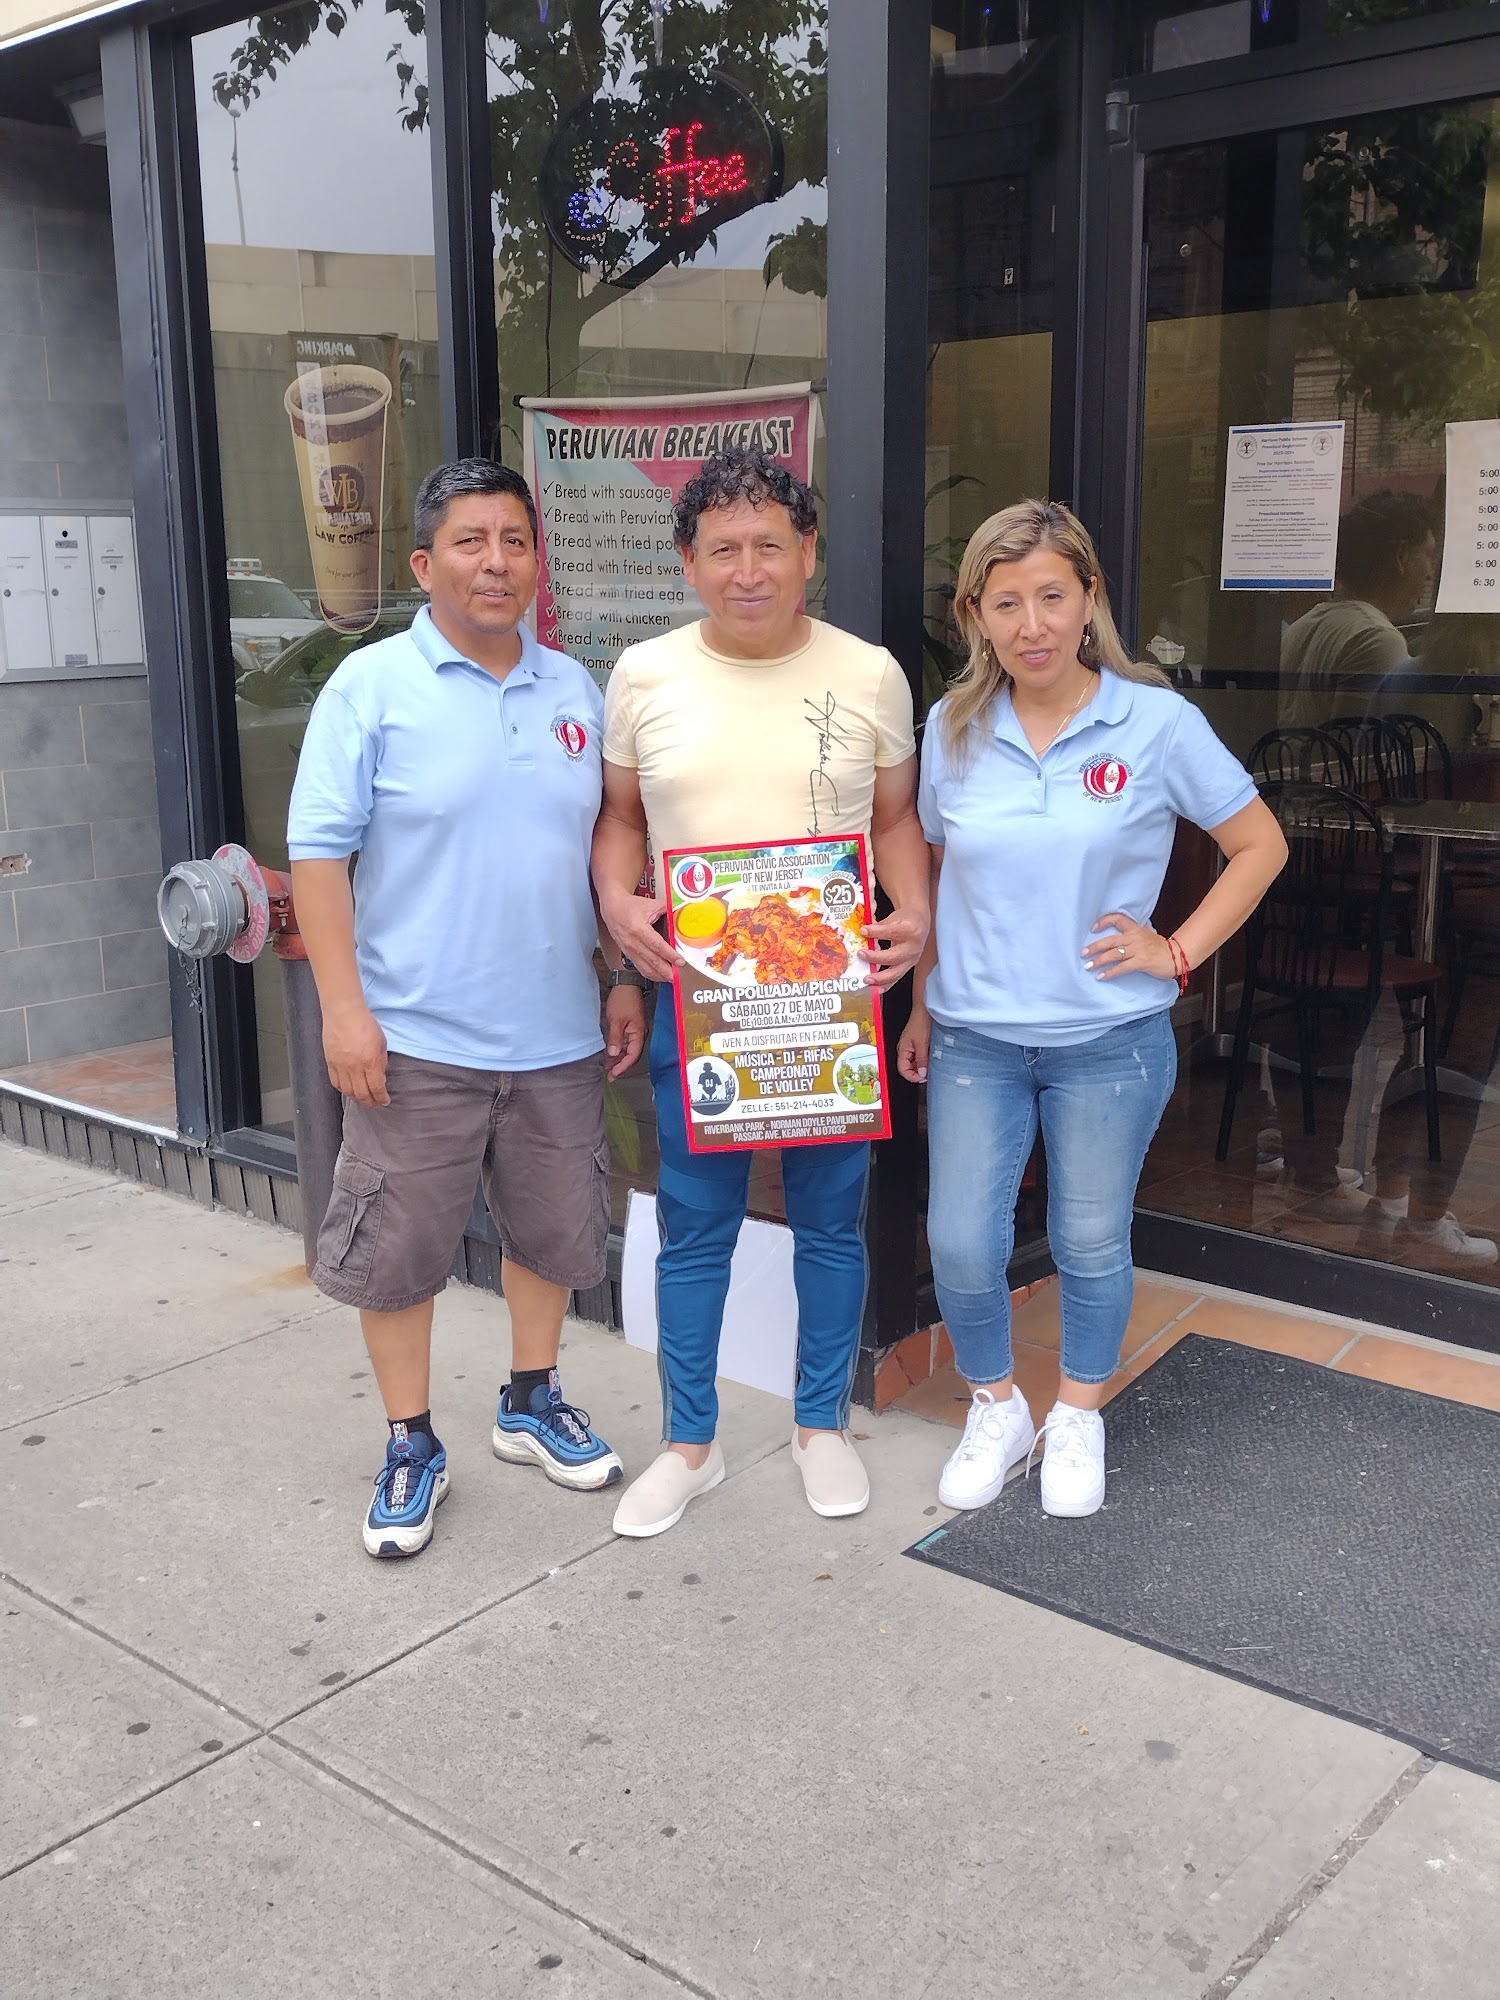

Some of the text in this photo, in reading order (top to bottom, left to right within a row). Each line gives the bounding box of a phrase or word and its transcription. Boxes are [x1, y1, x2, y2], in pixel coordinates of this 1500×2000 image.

[606, 122, 749, 228] Coffee
[545, 419, 793, 460] PERUVIAN BREAKFAST
[1480, 469, 1500, 478] 5:00
[555, 483, 672, 503] Bread with sausage
[1478, 486, 1499, 496] 5:00
[554, 508, 674, 526] Bread with Peruvian
[1478, 505, 1498, 514] 5:00
[315, 525, 336, 543] LAW
[554, 532, 591, 549] Bread
[595, 534, 618, 551] with
[621, 536, 651, 551] fried
[554, 557, 593, 573] Bread
[599, 558, 619, 575] with
[622, 560, 652, 576] fried
[555, 581, 684, 606] Bread with fried egg
[557, 606, 670, 625] Bread with chicken
[558, 630, 592, 645] Bread
[597, 632, 623, 647] with
[714, 853, 831, 873] PERUVIAN CIVIC ASSOCIATION
[742, 868, 804, 884] OF NEW JERSEY
[759, 883, 778, 892] INVITA
[825, 884, 852, 905] $25
[829, 905, 852, 914] INCLUYE
[693, 989, 733, 1004] GRAN
[735, 984, 799, 1001] POLLADA
[809, 977, 859, 996] PICNIC
[729, 997, 834, 1018] SÁBADO 27 DE MAYO
[743, 1037, 750, 1046] A
[751, 1033, 798, 1046] DISFRUTAR
[800, 1032, 812, 1042] EN
[812, 1028, 850, 1041] FAMILIA!
[735, 1053, 775, 1068] MÚSICA
[783, 1053, 796, 1064] DJ
[804, 1049, 834, 1062] RIFAS
[750, 1064, 821, 1081] CAMPEONATO
[705, 1078, 714, 1087] DJ
[759, 1078, 814, 1095] DE VOLLEY
[741, 1099, 834, 1113] ZELLE: 551-214-4033
[704, 1123, 744, 1135] RIVERBANK
[745, 1121, 765, 1132] PARK
[770, 1118, 801, 1130] NORMAN
[802, 1116, 825, 1128] DOYLE
[826, 1113, 859, 1126] PAVILION
[859, 1113, 874, 1123] 922
[733, 1131, 764, 1142] PASSAIC
[812, 1127, 822, 1136] NJ
[822, 1124, 846, 1135] 07032
